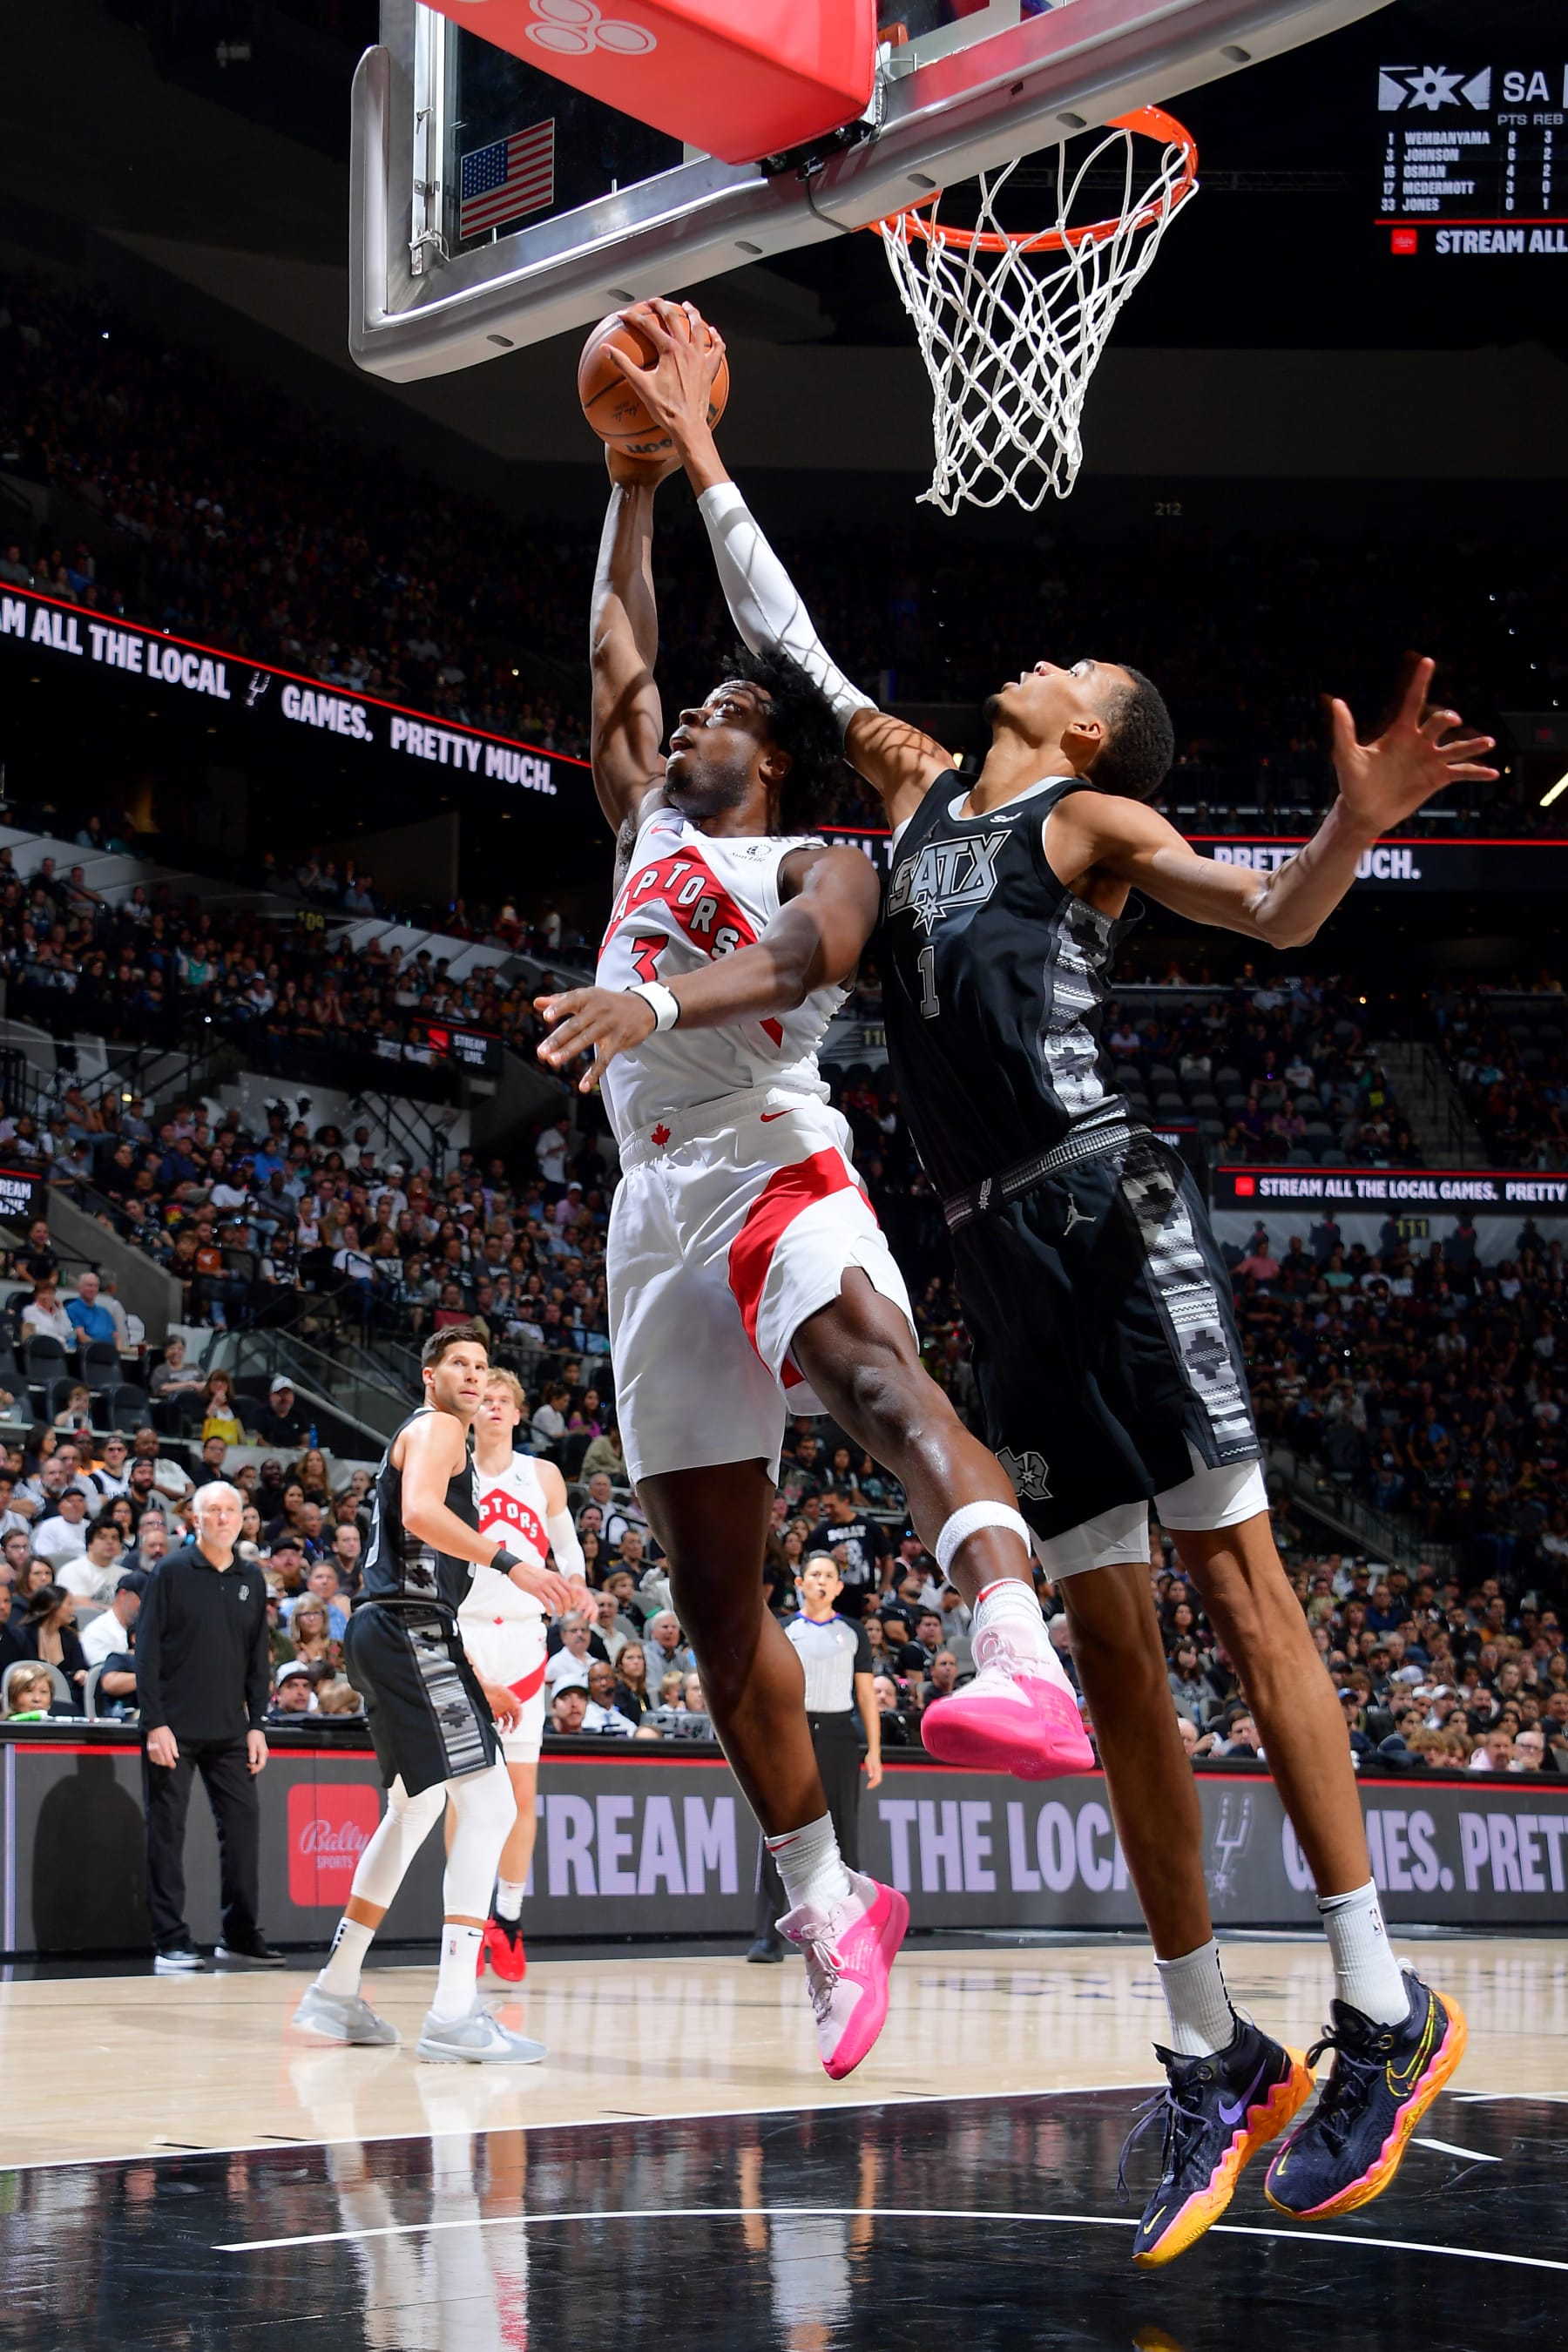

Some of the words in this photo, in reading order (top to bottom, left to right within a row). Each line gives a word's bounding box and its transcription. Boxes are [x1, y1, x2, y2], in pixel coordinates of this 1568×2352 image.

[1503, 71, 1550, 103] SA
[1497, 114, 1528, 125] PTS
[1533, 113, 1564, 125] REB
[1389, 132, 1395, 145] 1
[1544, 130, 1552, 144] 3
[1386, 147, 1394, 161] 3
[1403, 147, 1460, 162] JOHNSON
[1543, 146, 1551, 160] 2
[1402, 164, 1447, 179] OSMAN
[1506, 164, 1515, 177] 4
[1543, 164, 1551, 177] 2
[1383, 180, 1396, 195] 17
[1402, 180, 1476, 195] MCDERMOTT
[1505, 180, 1514, 194] 3
[1381, 197, 1396, 212] 33
[1402, 197, 1440, 212] JONES
[1543, 197, 1549, 211] 1
[1436, 229, 1524, 253] STREAM
[1529, 228, 1568, 253] ALL
[1154, 502, 1183, 517] 212
[30, 607, 84, 656] ALL
[88, 623, 144, 673] THE
[146, 641, 231, 700] LOCAL
[280, 684, 374, 742] GAMES.
[389, 715, 483, 773] PRETTY
[484, 744, 558, 795] MUCH.
[888, 829, 1012, 917] SATX
[601, 862, 740, 962] APTORS
[631, 933, 670, 983] 3
[917, 945, 941, 1019] 1
[1259, 1178, 1323, 1198] STREAM
[1324, 1178, 1353, 1198] ALL
[1355, 1179, 1387, 1199] THE
[1389, 1180, 1437, 1200] LOCAL
[1439, 1180, 1499, 1200] GAMES.
[1505, 1182, 1567, 1202] PRETTY
[1396, 1220, 1429, 1238] 111
[299, 1819, 370, 1857] Bally
[878, 1799, 997, 1894] THE
[316, 1855, 355, 1869] SPORTS
